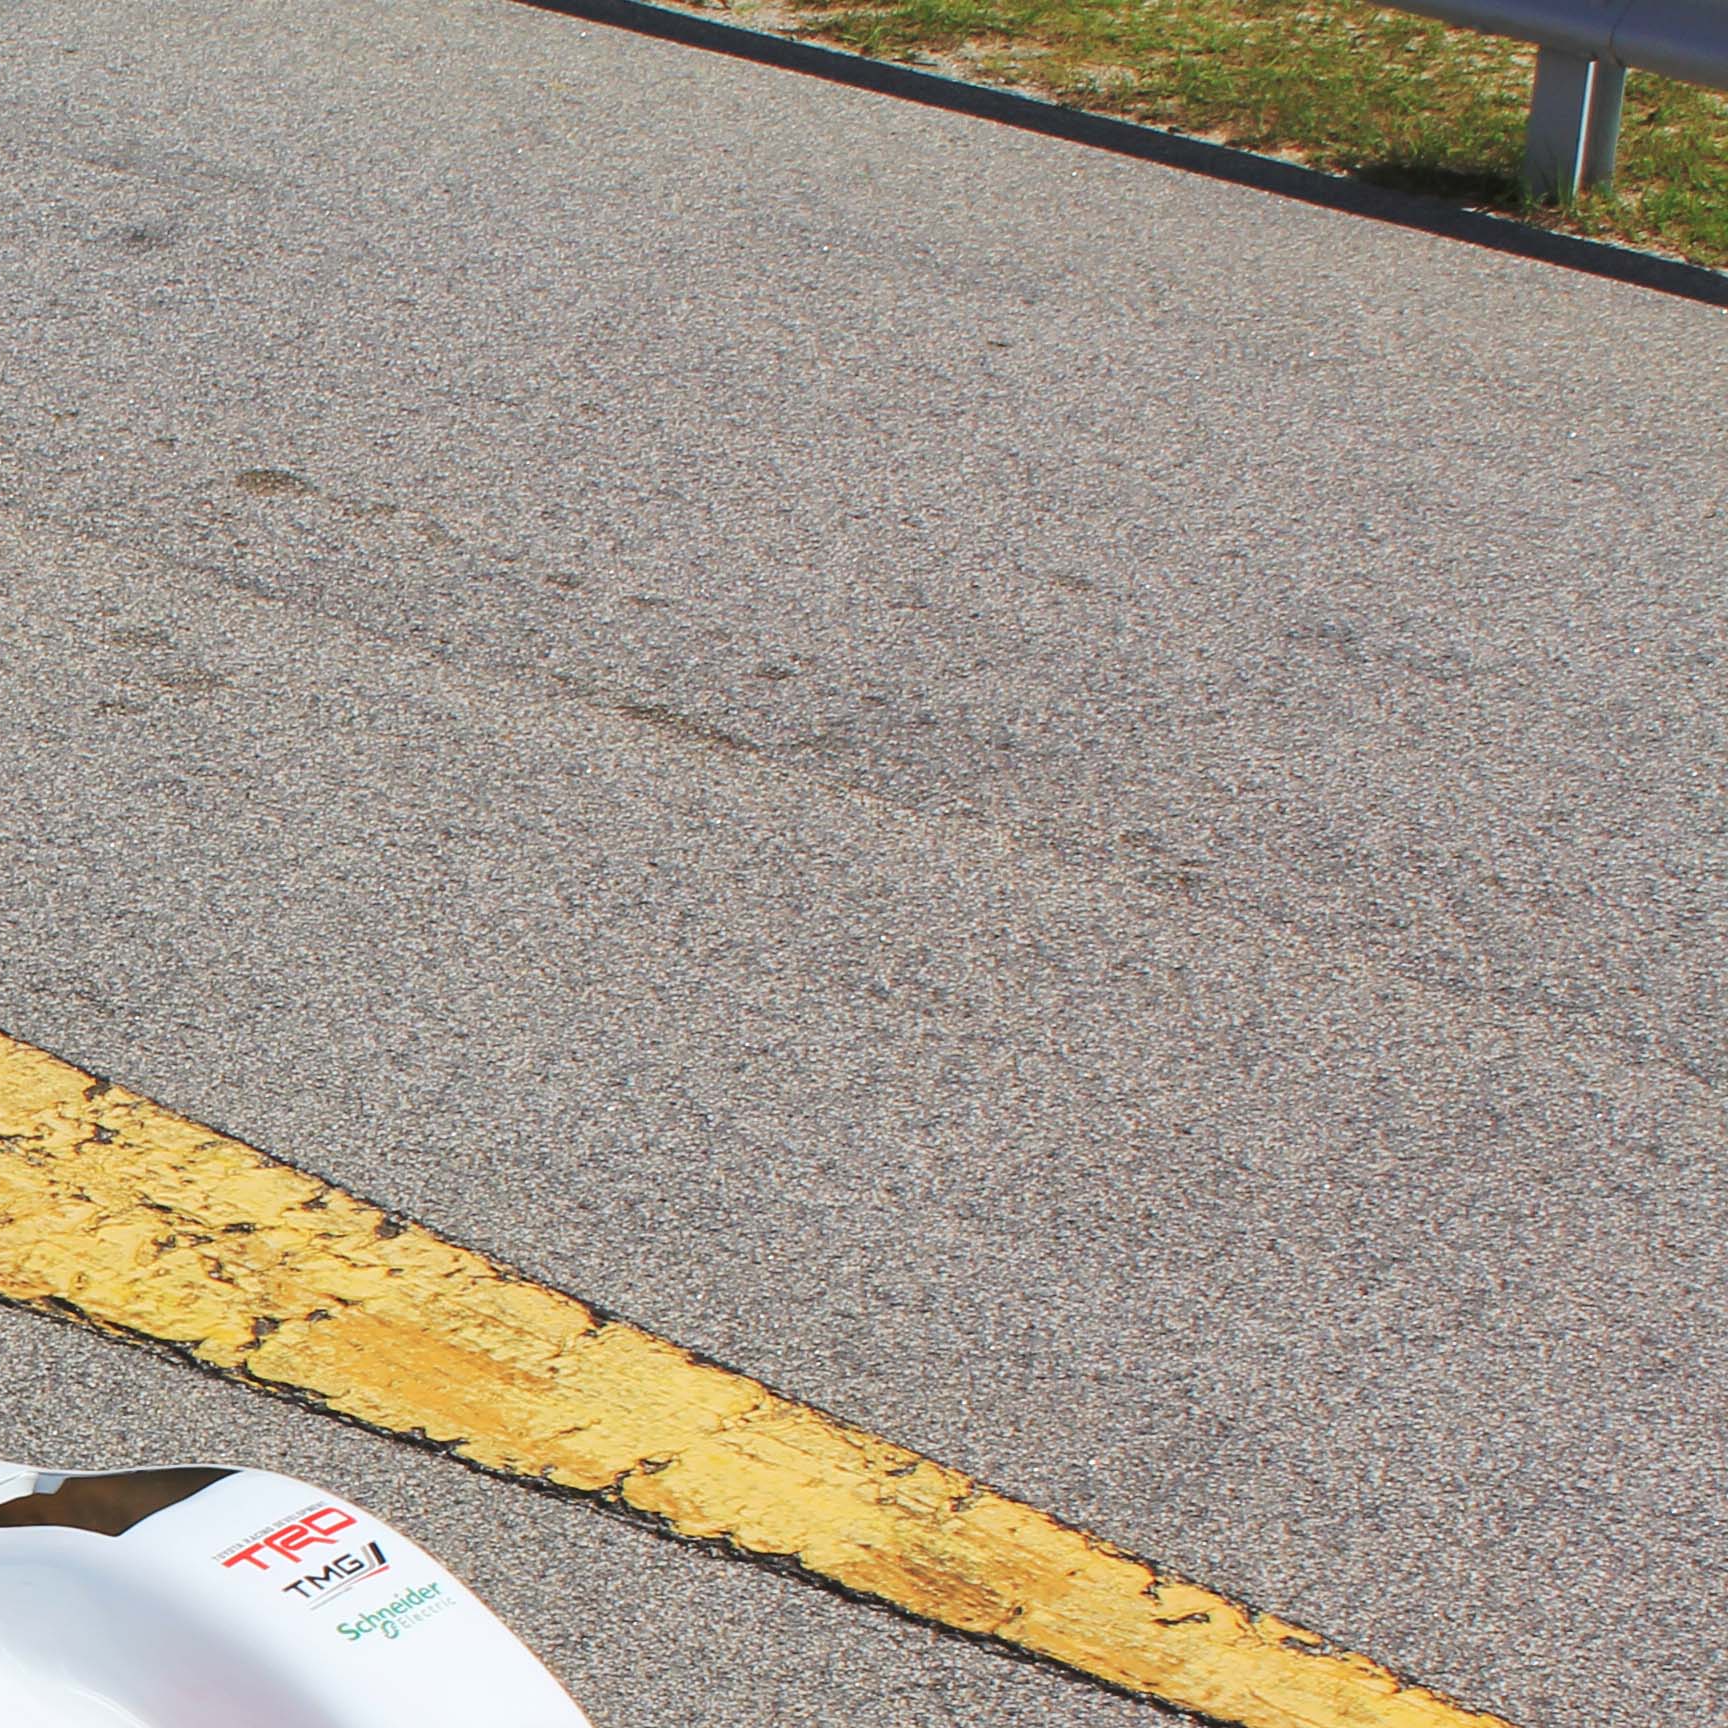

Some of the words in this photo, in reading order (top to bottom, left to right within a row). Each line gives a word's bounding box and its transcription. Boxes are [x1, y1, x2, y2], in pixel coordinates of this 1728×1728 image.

[221, 1506, 358, 1570] TRD
[282, 1553, 365, 1598] TMG
[336, 1581, 443, 1641] Schneider
